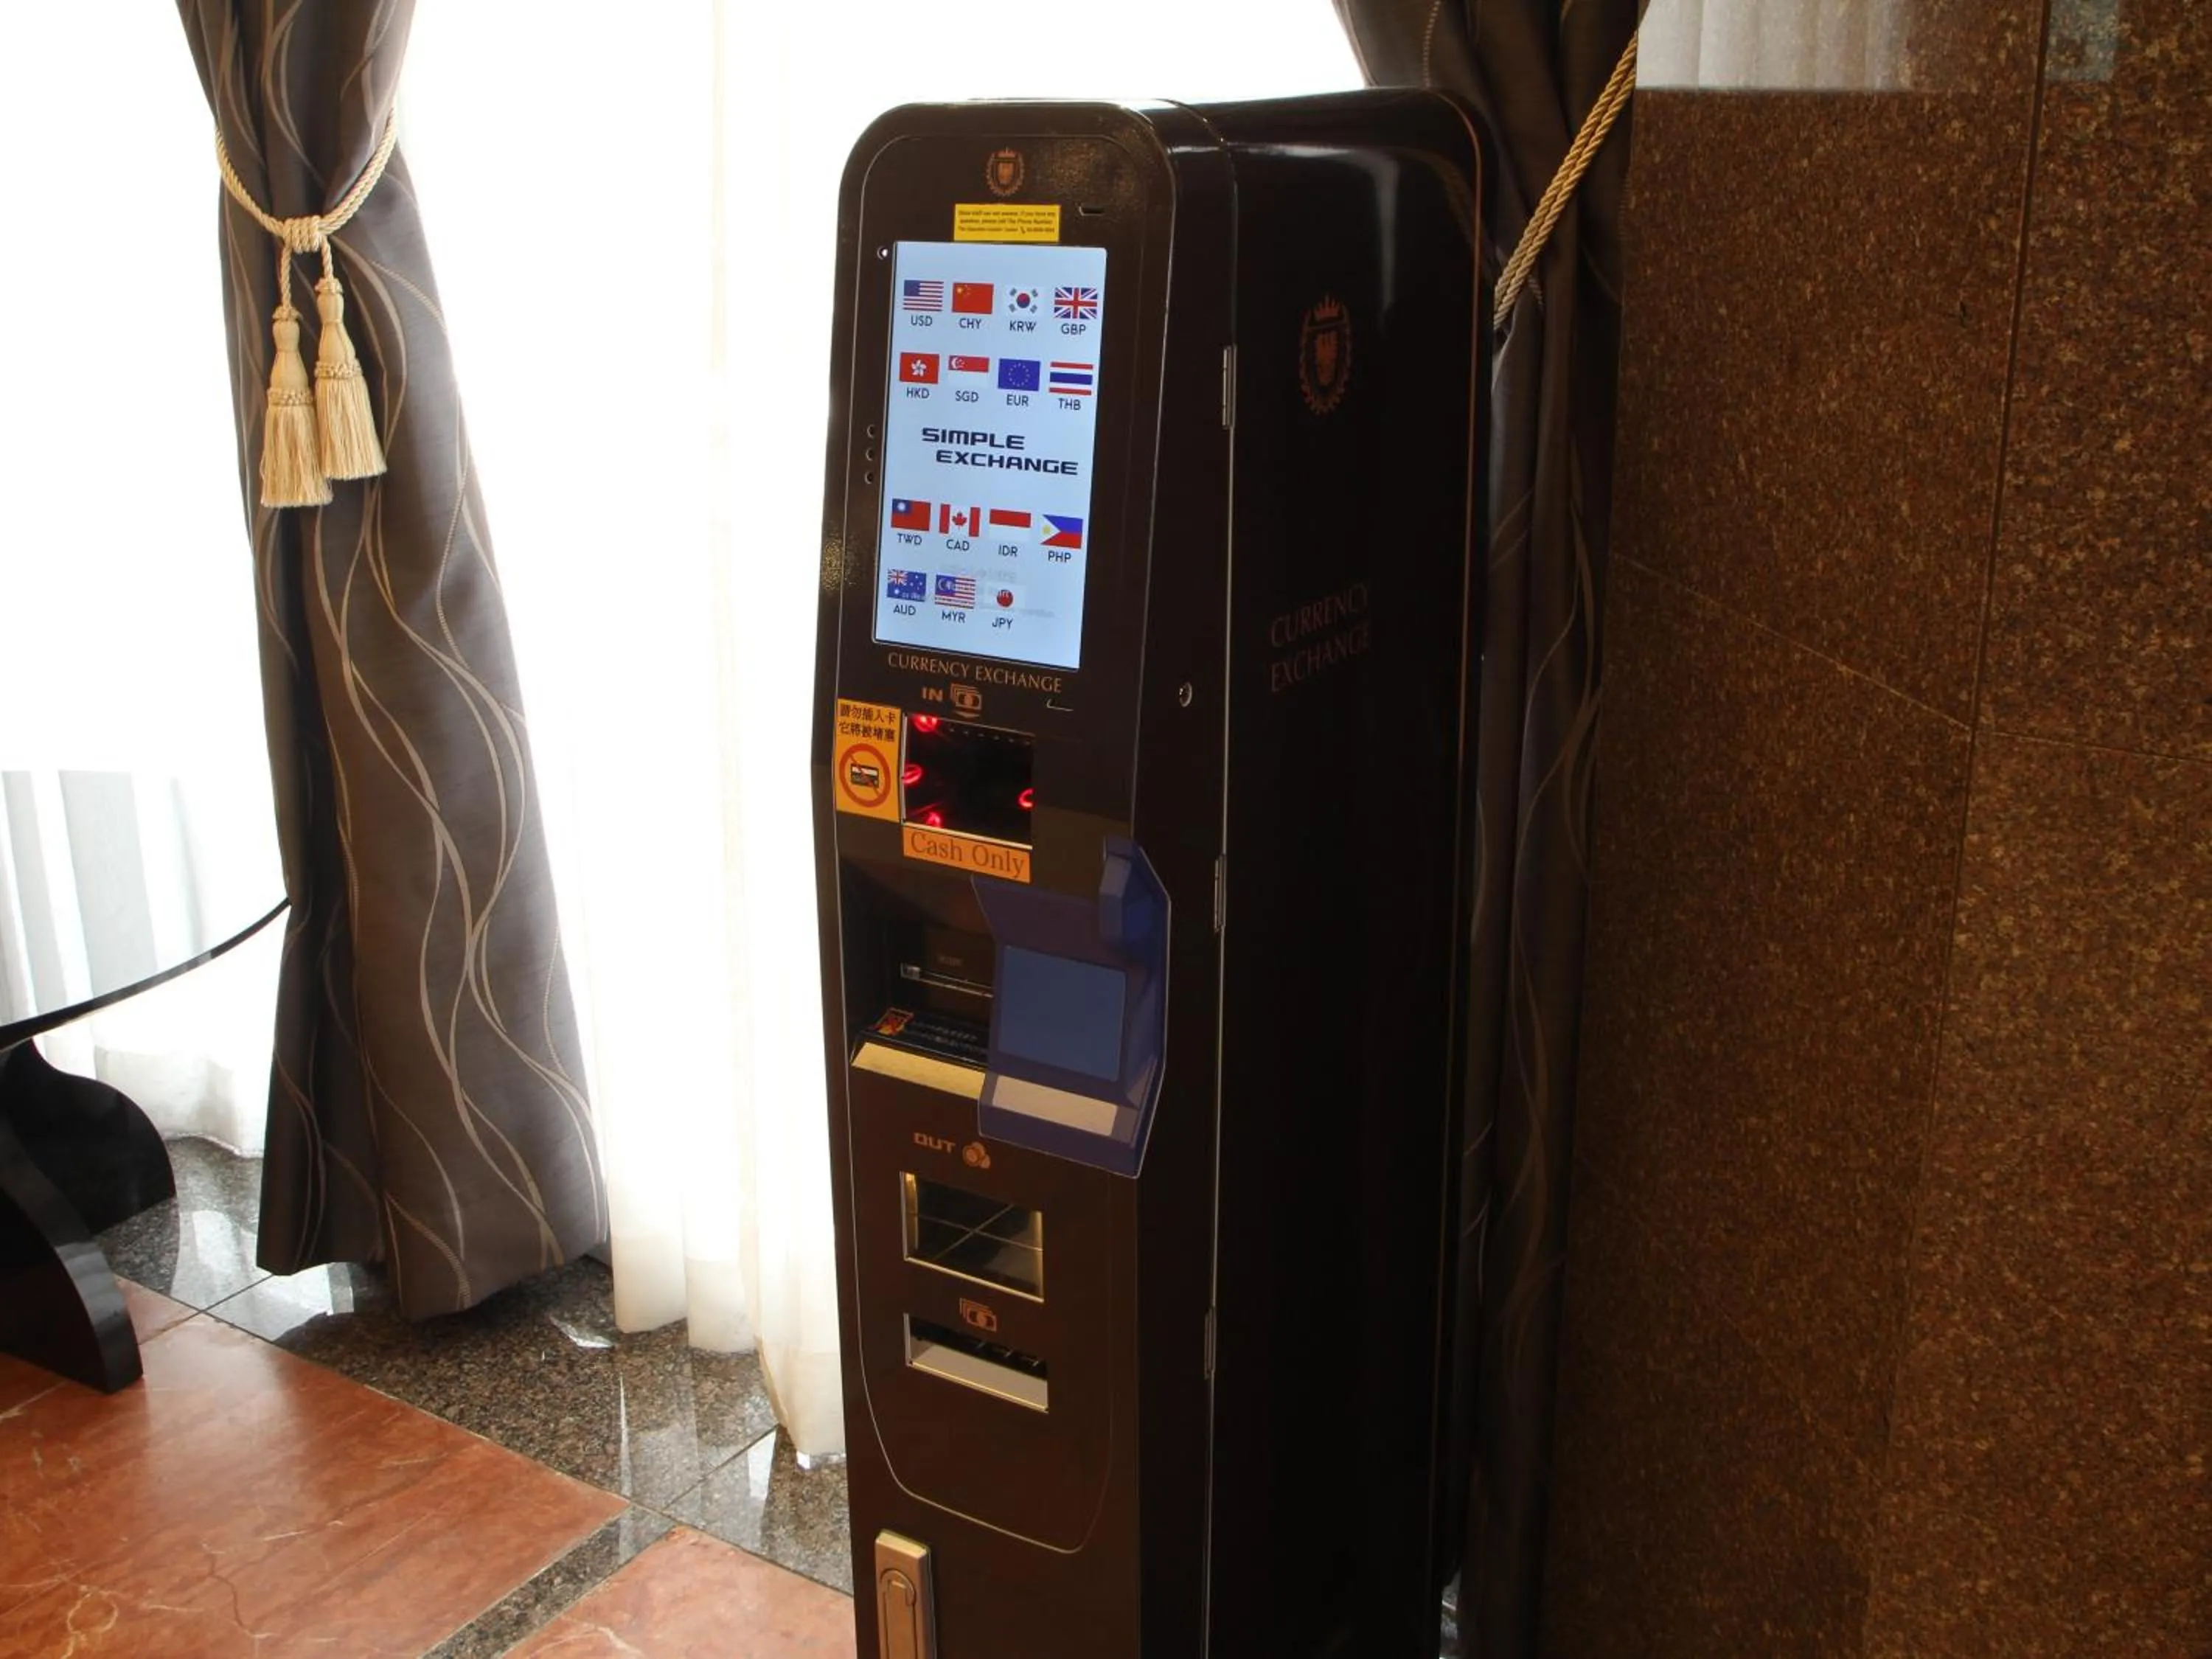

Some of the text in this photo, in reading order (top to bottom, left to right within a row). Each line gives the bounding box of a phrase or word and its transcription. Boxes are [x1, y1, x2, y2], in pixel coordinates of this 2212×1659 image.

[911, 316, 933, 327] USD
[959, 318, 982, 330] CHY
[1009, 321, 1037, 332] KRW
[1061, 323, 1086, 335] GBP
[906, 388, 930, 399] HKD
[955, 391, 979, 403] SGD
[1006, 394, 1029, 407] EUR
[1058, 398, 1082, 411] THB
[922, 428, 1025, 451] SIMPLE
[936, 450, 1078, 476] EXCHANGE
[897, 533, 922, 546] TWD
[946, 539, 970, 552] CAD
[998, 545, 1018, 557] IDR
[1048, 550, 1071, 563] PHP
[893, 604, 917, 616] AUD
[1271, 582, 1368, 648] CURRENCY
[942, 611, 965, 624] MYR
[992, 617, 1013, 630] JPY
[1271, 622, 1369, 692] EXCHANGE
[888, 652, 1062, 694] CURRENCY EXCHANGE
[922, 687, 943, 702] IN
[911, 832, 1024, 877] Cash Only
[914, 1132, 956, 1154] OUT
